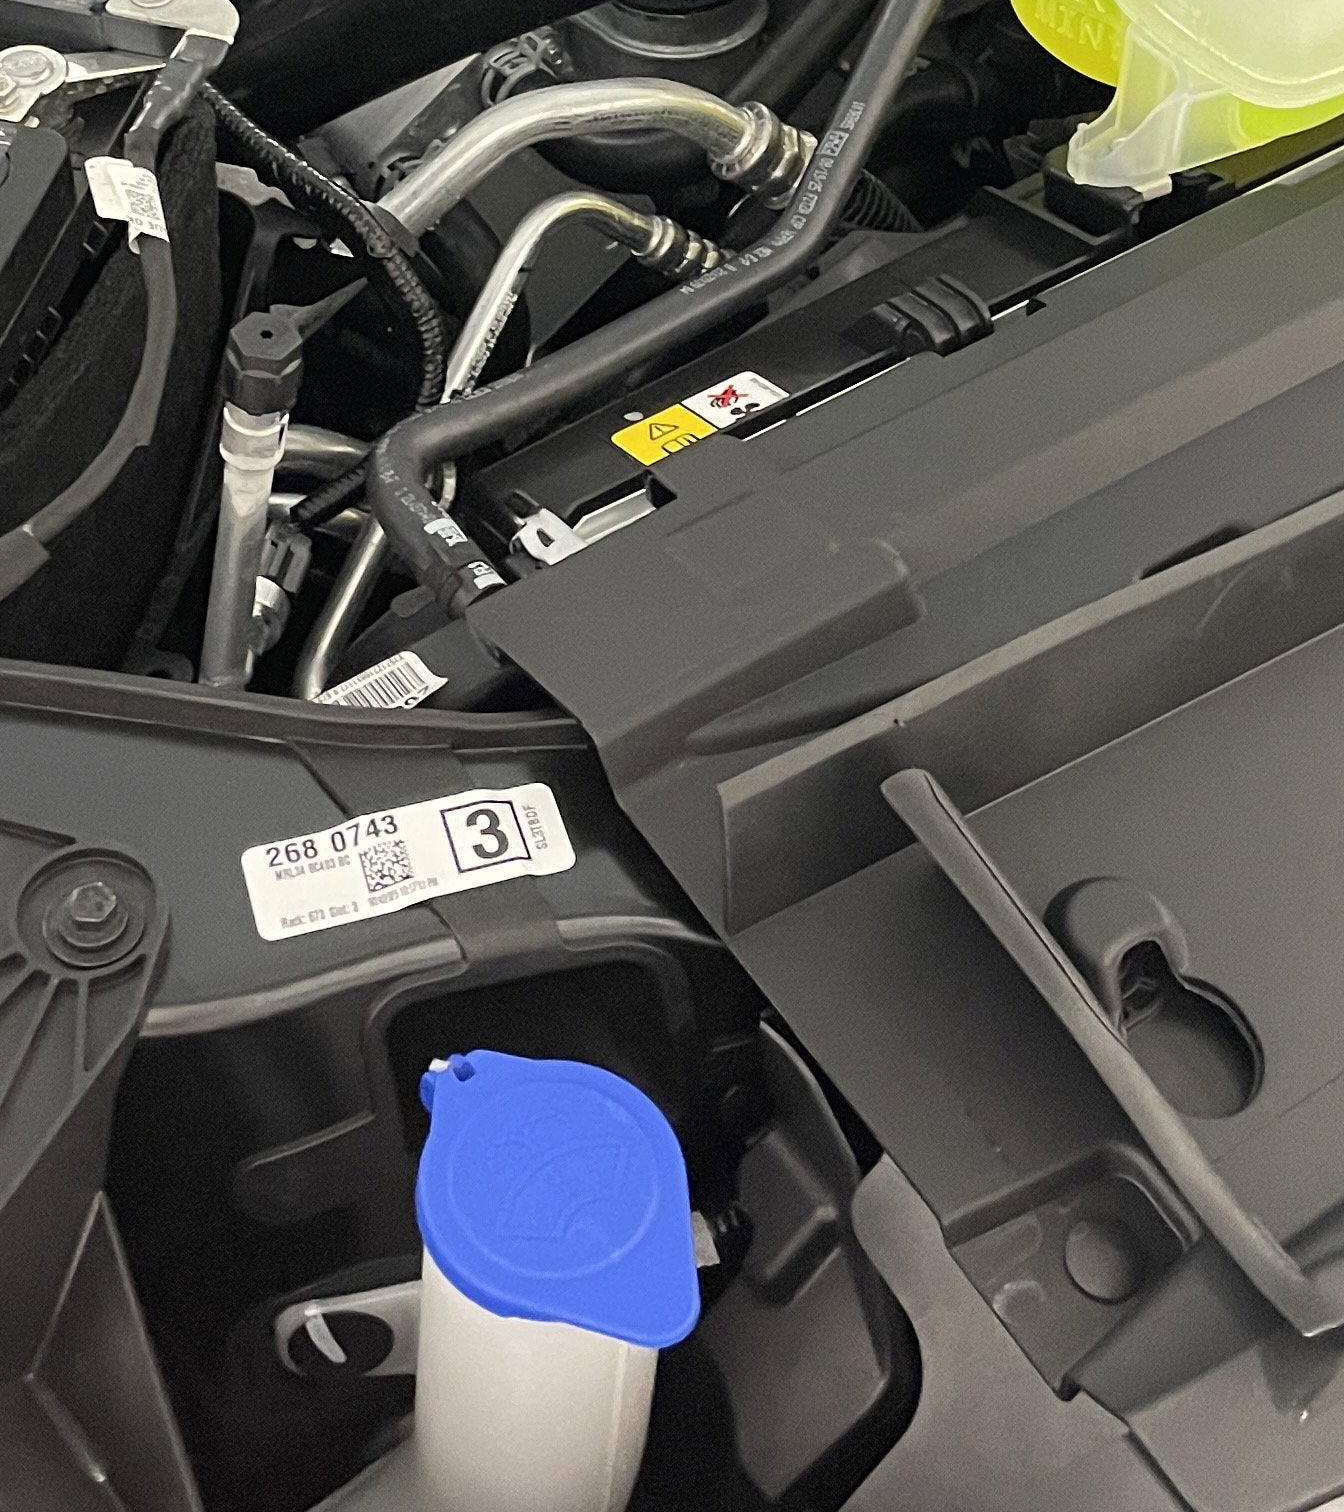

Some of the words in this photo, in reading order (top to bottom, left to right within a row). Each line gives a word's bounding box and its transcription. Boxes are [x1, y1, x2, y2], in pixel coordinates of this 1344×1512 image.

[265, 838, 319, 869] 268
[330, 814, 399, 854] 0743
[465, 808, 510, 860] 3
